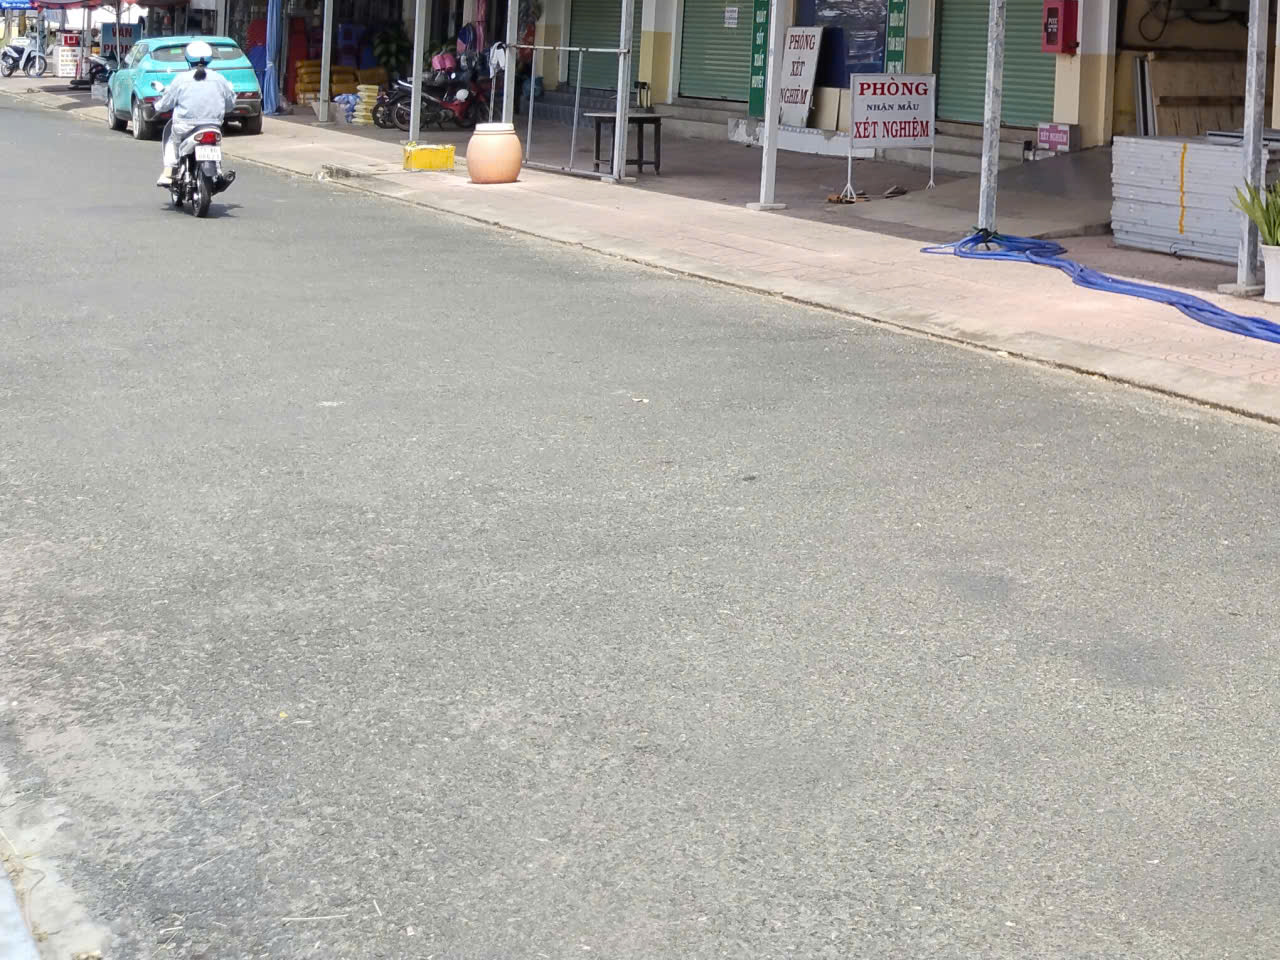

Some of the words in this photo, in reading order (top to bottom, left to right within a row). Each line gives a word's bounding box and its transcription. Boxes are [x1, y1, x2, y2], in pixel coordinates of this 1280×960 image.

[790, 56, 805, 77] XÉT
[858, 76, 929, 96] PHÒNG
[866, 102, 894, 112] NHẬN
[897, 100, 919, 111] MẪU
[853, 116, 878, 138] XÉT
[882, 116, 929, 141] NGHIỆM
